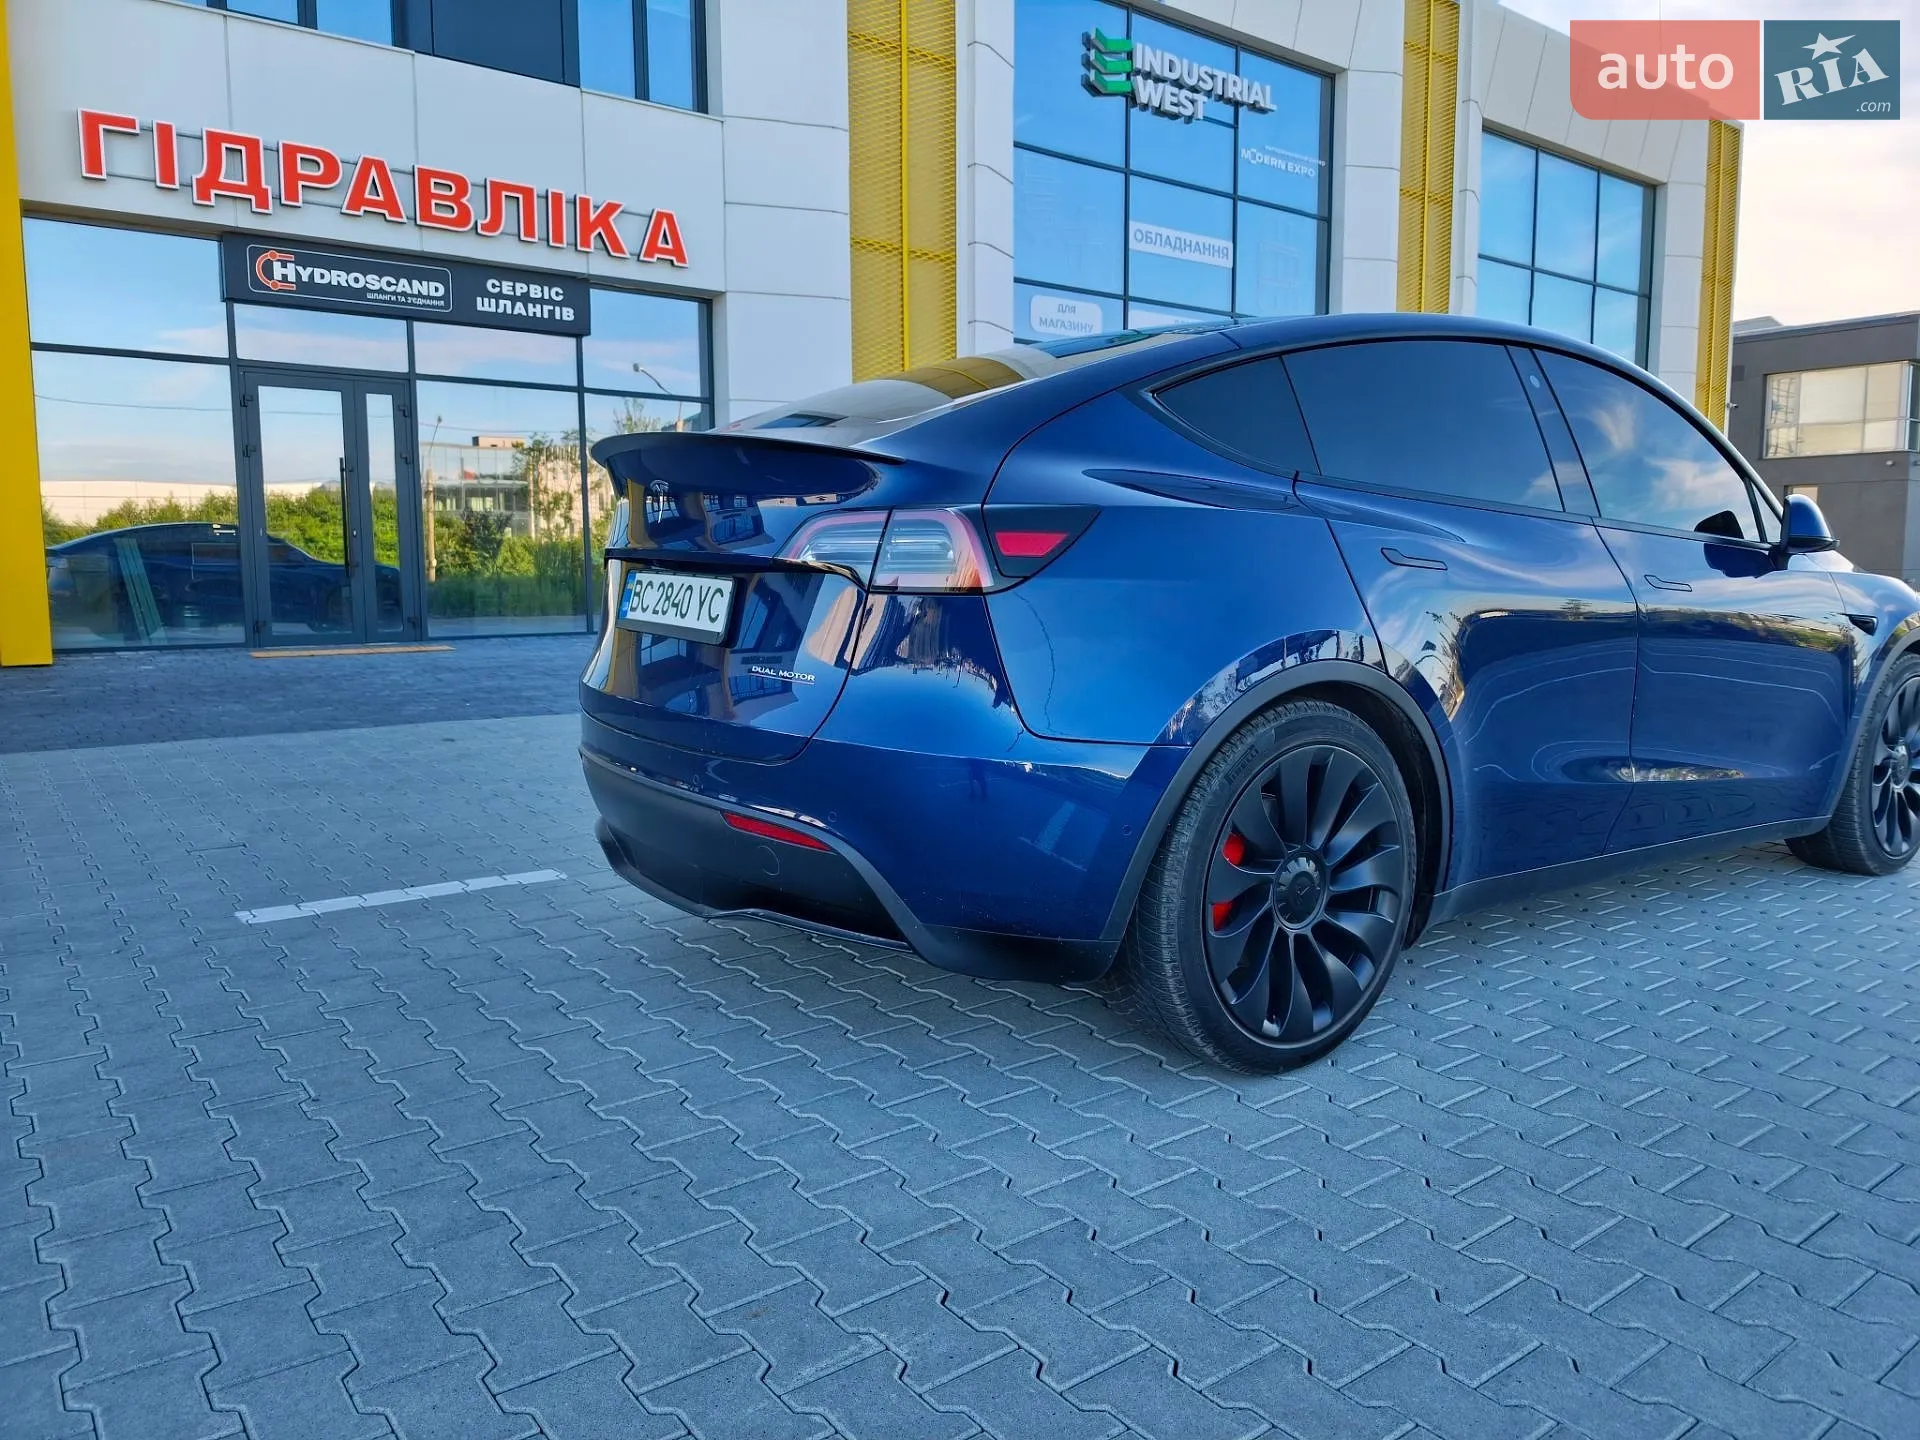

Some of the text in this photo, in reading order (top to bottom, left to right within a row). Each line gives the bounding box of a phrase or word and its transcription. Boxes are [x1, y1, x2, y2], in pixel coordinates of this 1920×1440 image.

[1134, 42, 1277, 112] INDUSTRIAL
[1131, 75, 1207, 120] WEST
[77, 107, 689, 268] ГІДРАВЛІКА
[1133, 228, 1230, 262] ОБЛАДНАННЯ
[272, 258, 446, 298] HYDROSCAND
[486, 278, 564, 301] СЕРВІС
[476, 297, 575, 322] ШЛАНГІВ
[1039, 317, 1094, 333] МАГАЗИНУ
[630, 579, 724, 624] BC 2840 YC
[751, 665, 816, 681] DUAL MOTOR
